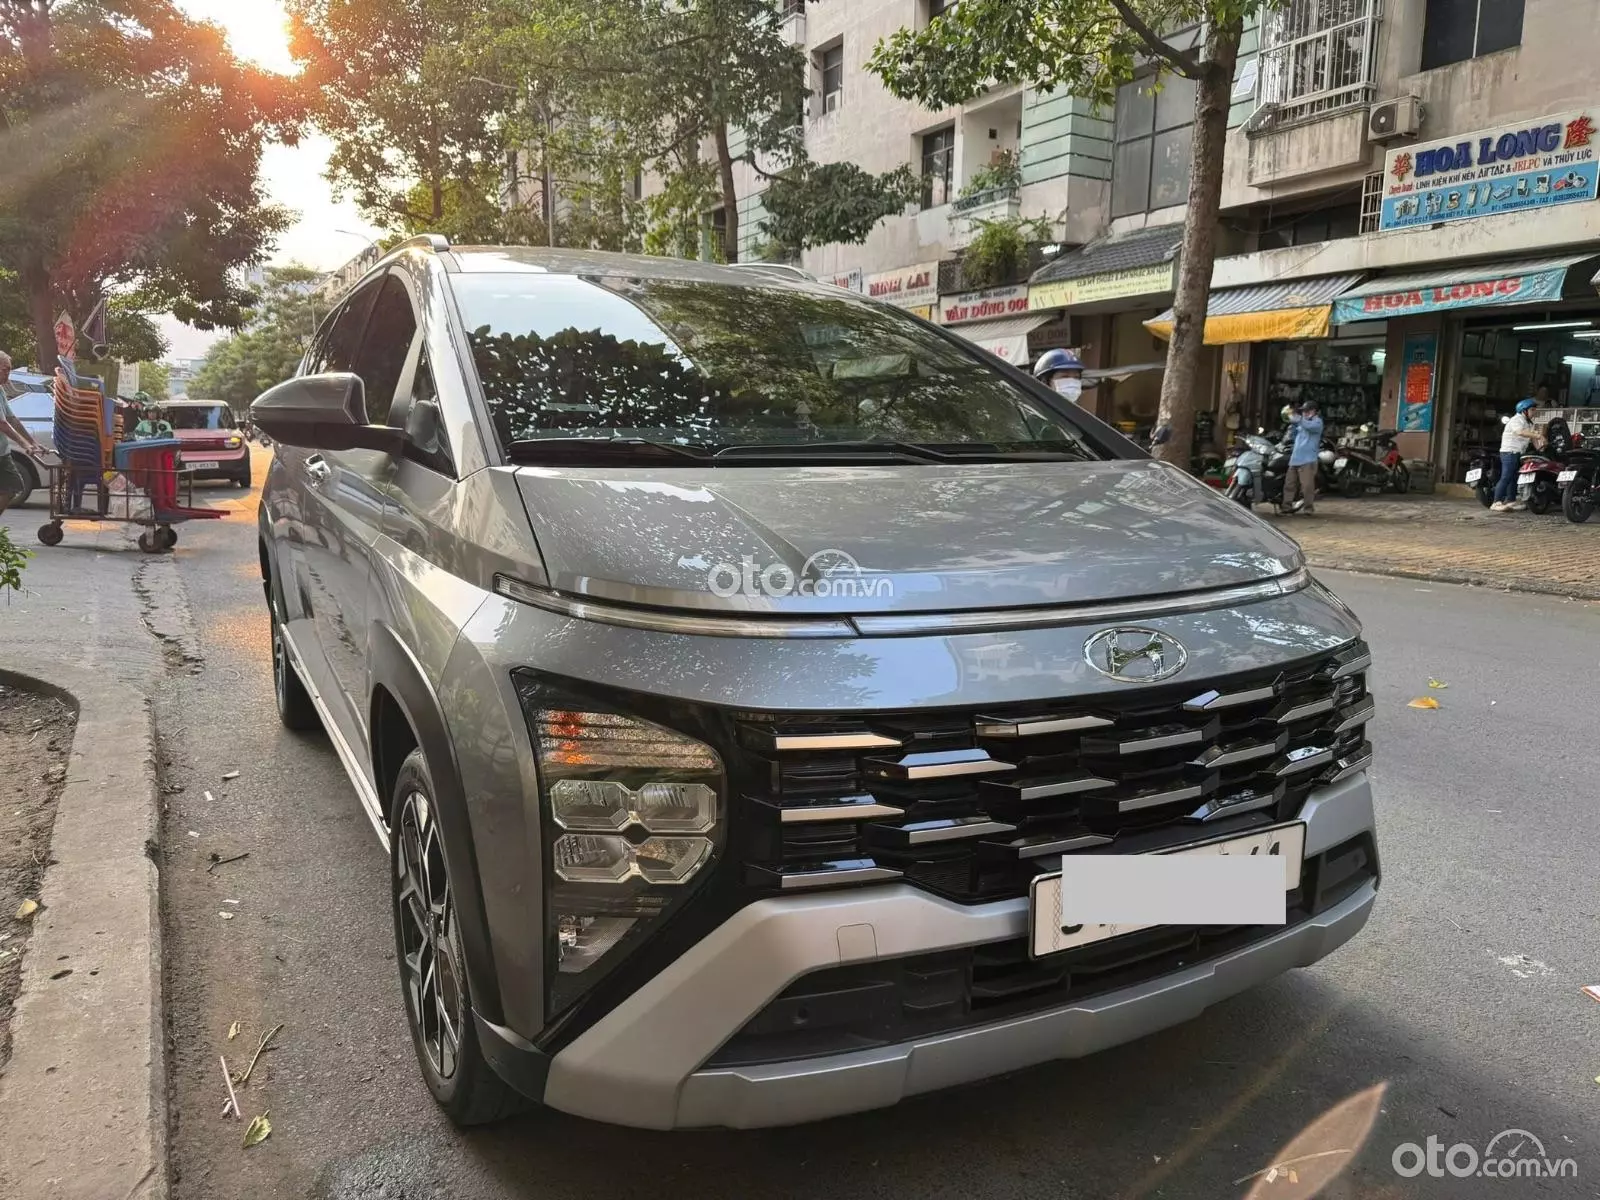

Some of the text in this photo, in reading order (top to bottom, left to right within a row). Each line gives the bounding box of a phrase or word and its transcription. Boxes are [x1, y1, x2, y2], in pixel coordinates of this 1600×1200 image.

[1414, 122, 1561, 178] HOA LONG
[1563, 115, 1597, 149] 隆
[1416, 180, 1431, 190] LINH
[1432, 175, 1448, 188] KIỆN
[1448, 173, 1461, 184] KHÍ
[1506, 164, 1512, 173] &
[1512, 158, 1541, 173] JELPC
[1543, 156, 1553, 167] VÀ
[1577, 149, 1593, 161] LỰC
[1363, 290, 1423, 312] HOA
[1433, 277, 1523, 302] LONG
